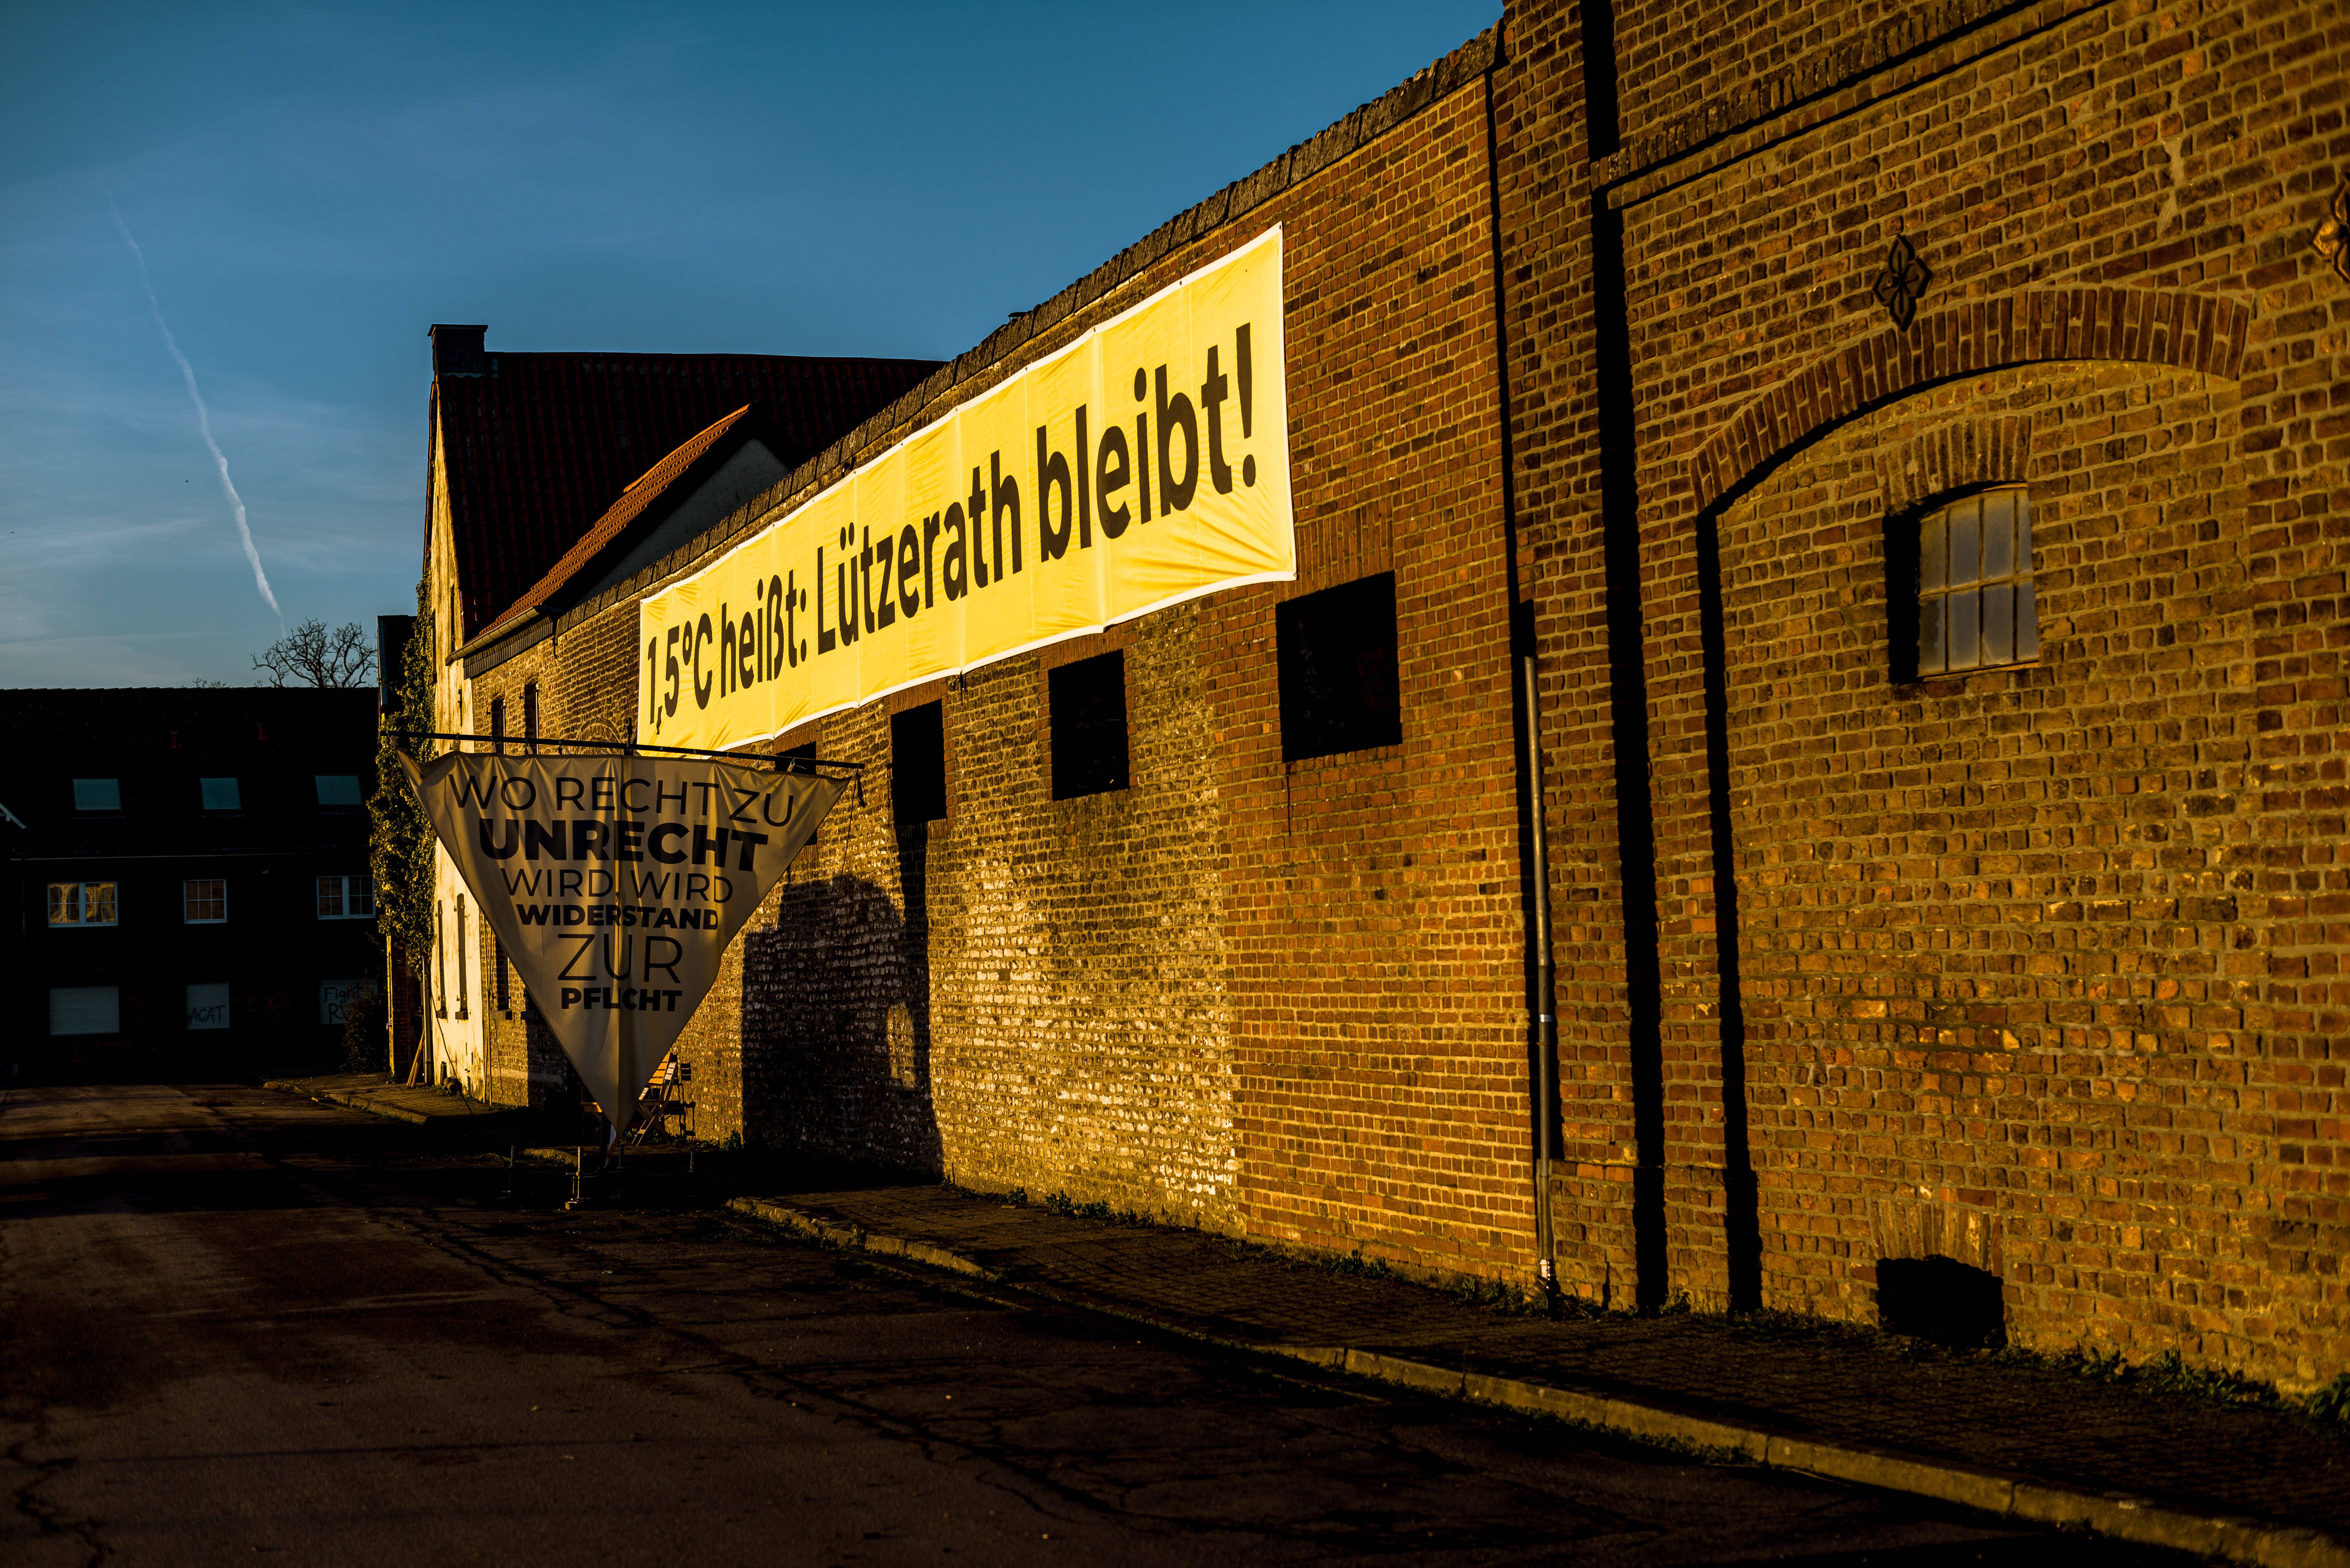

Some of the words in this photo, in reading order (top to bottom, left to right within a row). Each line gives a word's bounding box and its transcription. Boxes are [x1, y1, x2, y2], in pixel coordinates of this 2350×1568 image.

[721, 569, 807, 698] heißt:
[817, 450, 1022, 655] Lützerath
[1037, 322, 1256, 562] bleibt!
[448, 774, 536, 811] WO
[556, 777, 719, 816] RECHT
[729, 788, 794, 827] ZU
[479, 818, 768, 871] UNRECHT
[630, 870, 733, 903] WIRD
[516, 904, 718, 930] WIDERSTAND
[558, 934, 682, 983] ZUR
